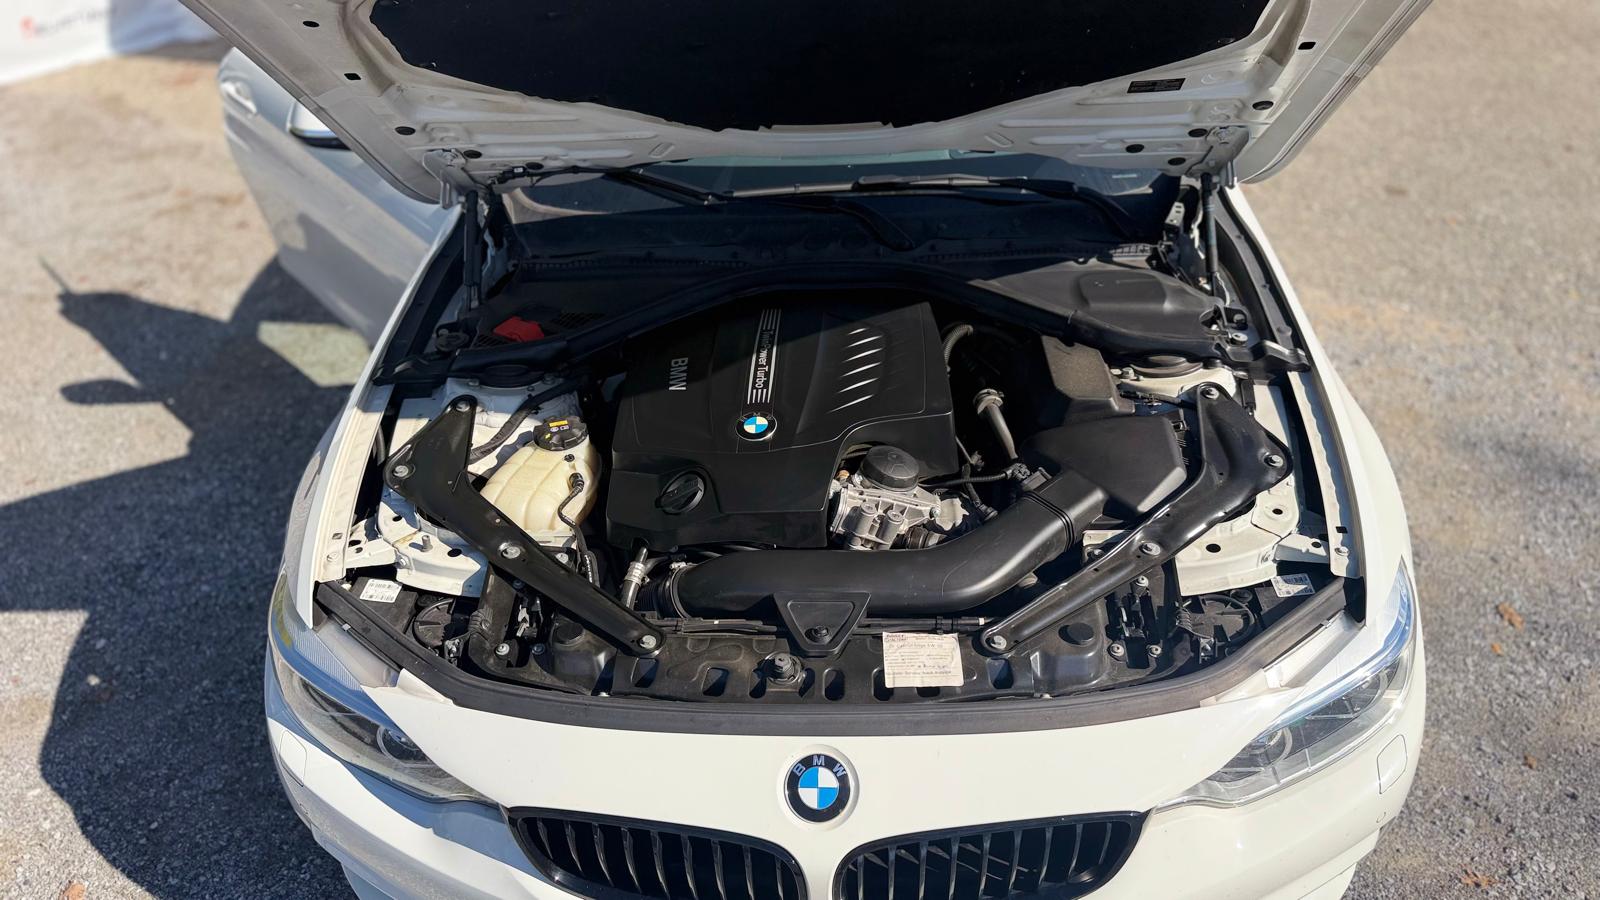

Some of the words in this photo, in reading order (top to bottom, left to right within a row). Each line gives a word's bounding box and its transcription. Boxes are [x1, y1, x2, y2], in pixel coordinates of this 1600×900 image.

[669, 357, 688, 391] BMW
[755, 365, 769, 389] Turbo
[793, 755, 847, 777] BMW
